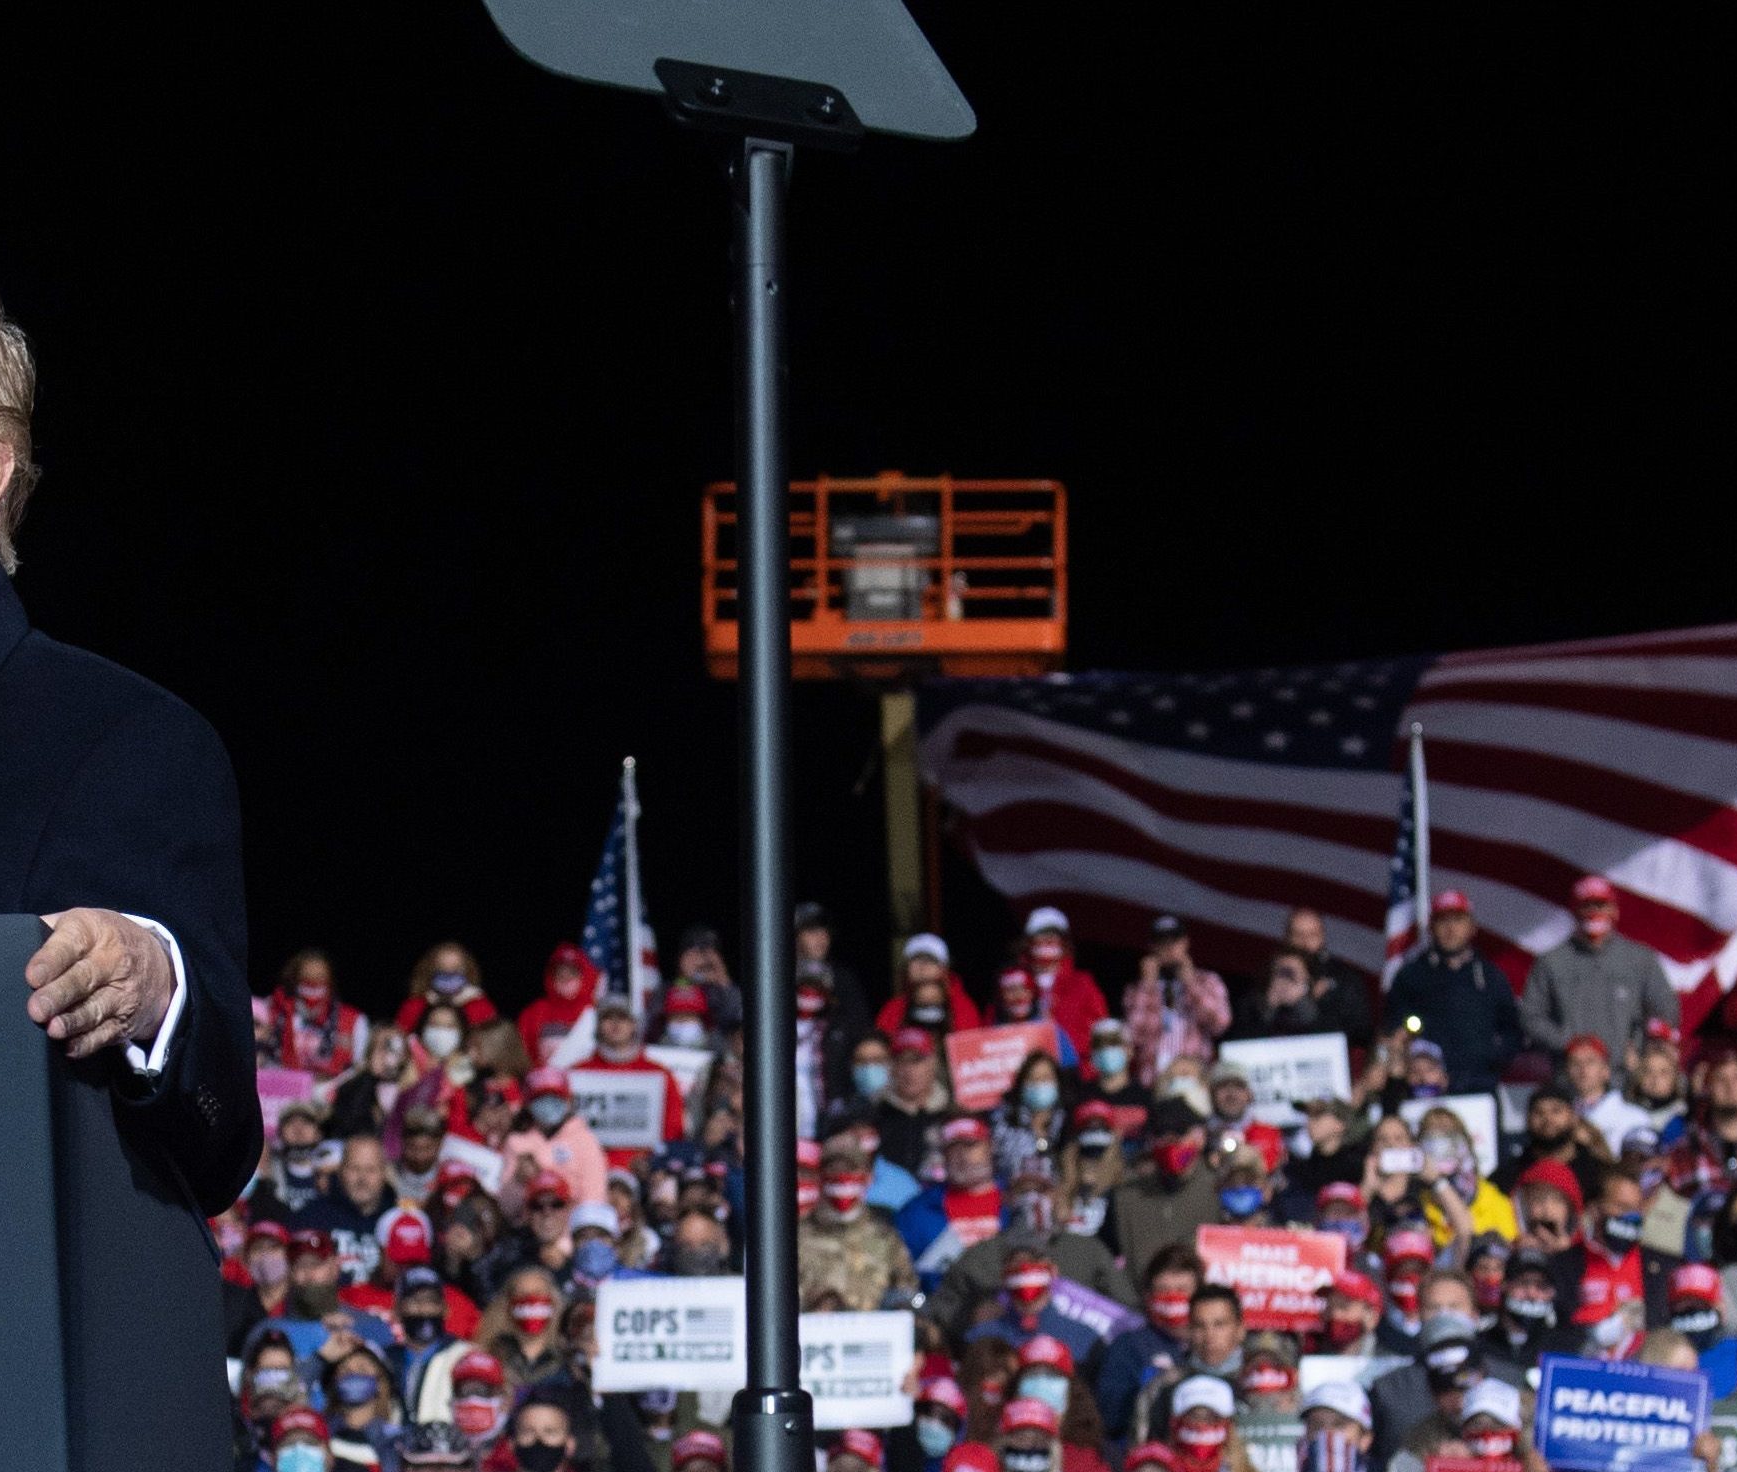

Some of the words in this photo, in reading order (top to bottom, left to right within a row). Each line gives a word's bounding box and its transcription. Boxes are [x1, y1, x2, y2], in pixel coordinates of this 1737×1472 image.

[614, 1308, 679, 1335] COPS
[803, 1344, 835, 1371] PS
[1553, 1387, 1694, 1423] PEACEFUL
[1551, 1416, 1691, 1451] PROTESTER
